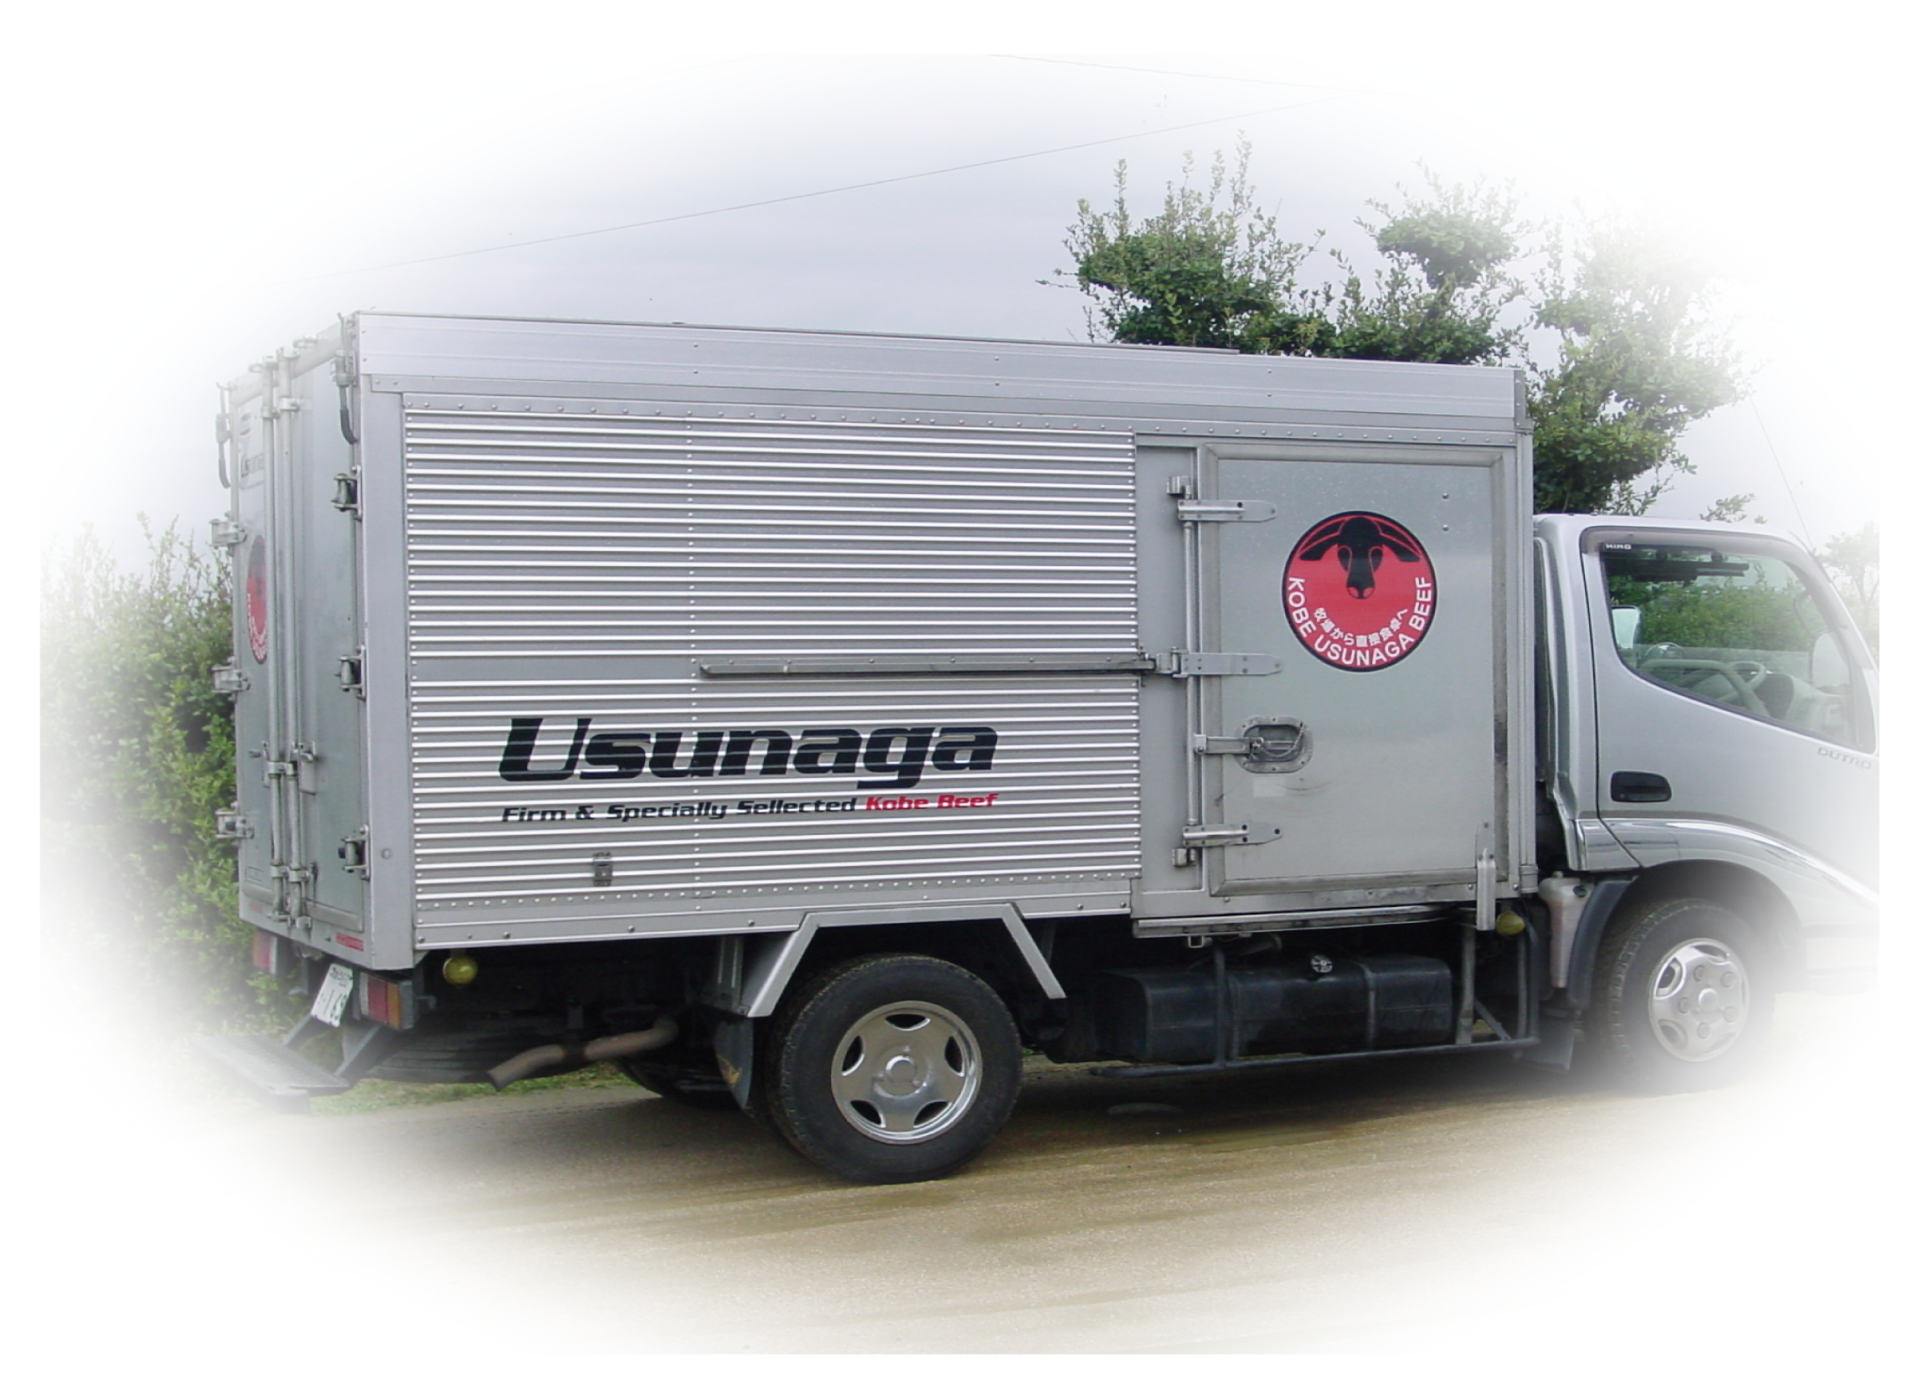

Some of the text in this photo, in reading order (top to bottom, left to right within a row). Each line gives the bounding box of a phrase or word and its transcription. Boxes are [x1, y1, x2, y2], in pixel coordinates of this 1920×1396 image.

[1288, 577, 1432, 666] KOBE USUNAGA BEEF
[498, 718, 999, 789] Usunaga
[1817, 747, 1872, 770] DUTRO
[502, 793, 999, 823] Firm & Specially Sellected Kobe Beef
